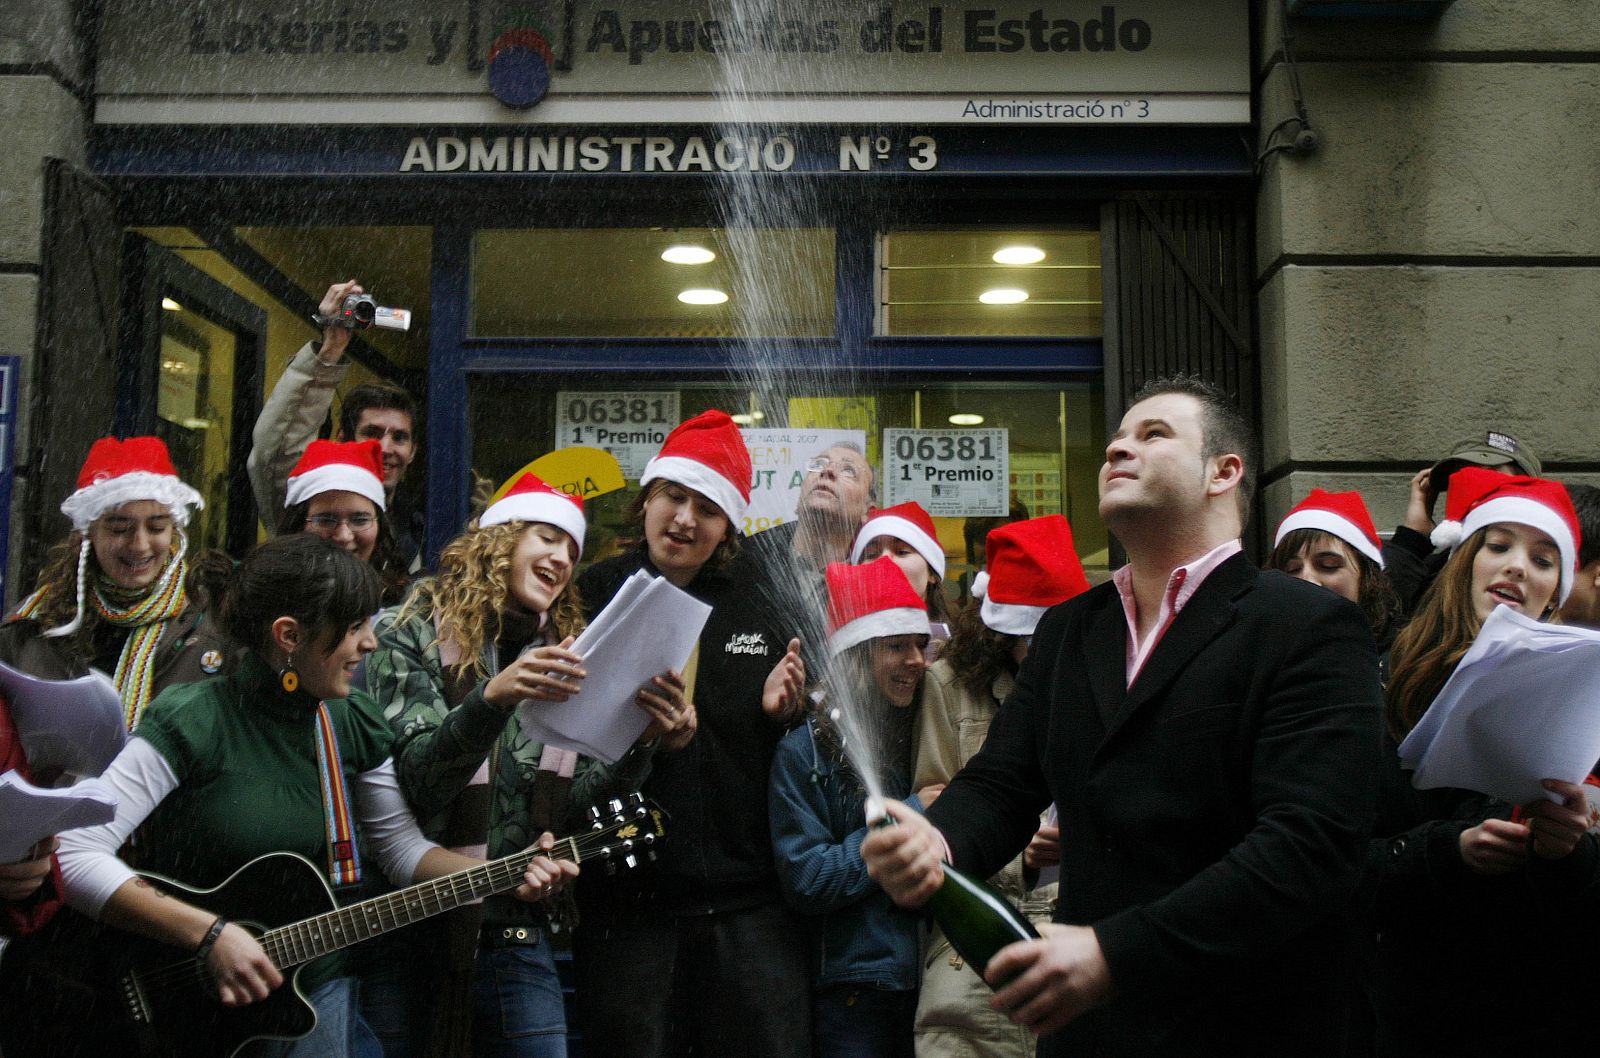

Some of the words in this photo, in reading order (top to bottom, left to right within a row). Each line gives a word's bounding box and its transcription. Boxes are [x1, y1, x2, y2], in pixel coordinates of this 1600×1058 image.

[190, 8, 409, 53] Loterias
[427, 20, 458, 66] y
[860, 7, 943, 53] del
[963, 7, 1152, 53] Estado
[962, 100, 1105, 119] Administració
[1137, 100, 1150, 118] 3
[400, 131, 795, 172] ADMINISTRACIÓ
[908, 136, 938, 171] 3
[567, 399, 668, 424] 06381
[597, 428, 665, 444] Premio
[797, 435, 818, 443] 2007
[753, 447, 791, 465] EMI
[896, 435, 996, 461] 06381
[925, 465, 994, 481] Premio
